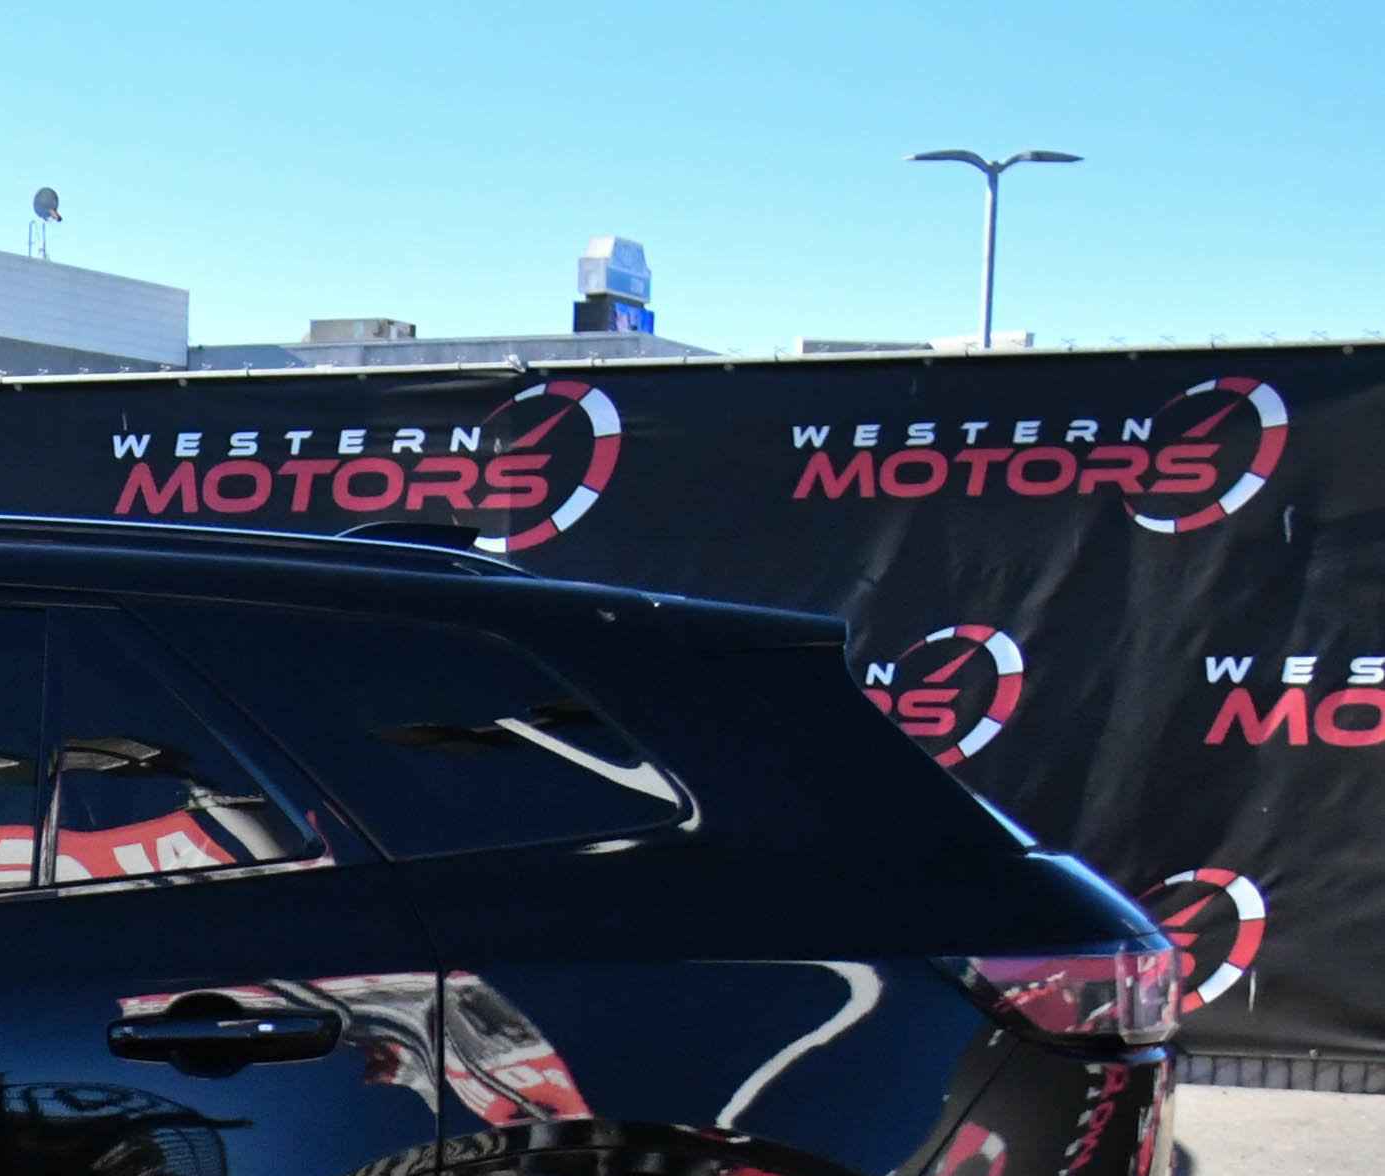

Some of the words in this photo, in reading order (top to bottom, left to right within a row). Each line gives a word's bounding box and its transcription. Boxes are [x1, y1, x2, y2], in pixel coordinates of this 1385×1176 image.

[112, 427, 481, 459] WESTERN
[792, 418, 1152, 449] WESTERN
[114, 454, 551, 514] MOTORS
[792, 443, 1220, 499] MOTORS
[1205, 656, 1385, 685] WES
[1203, 687, 1385, 747] MO
